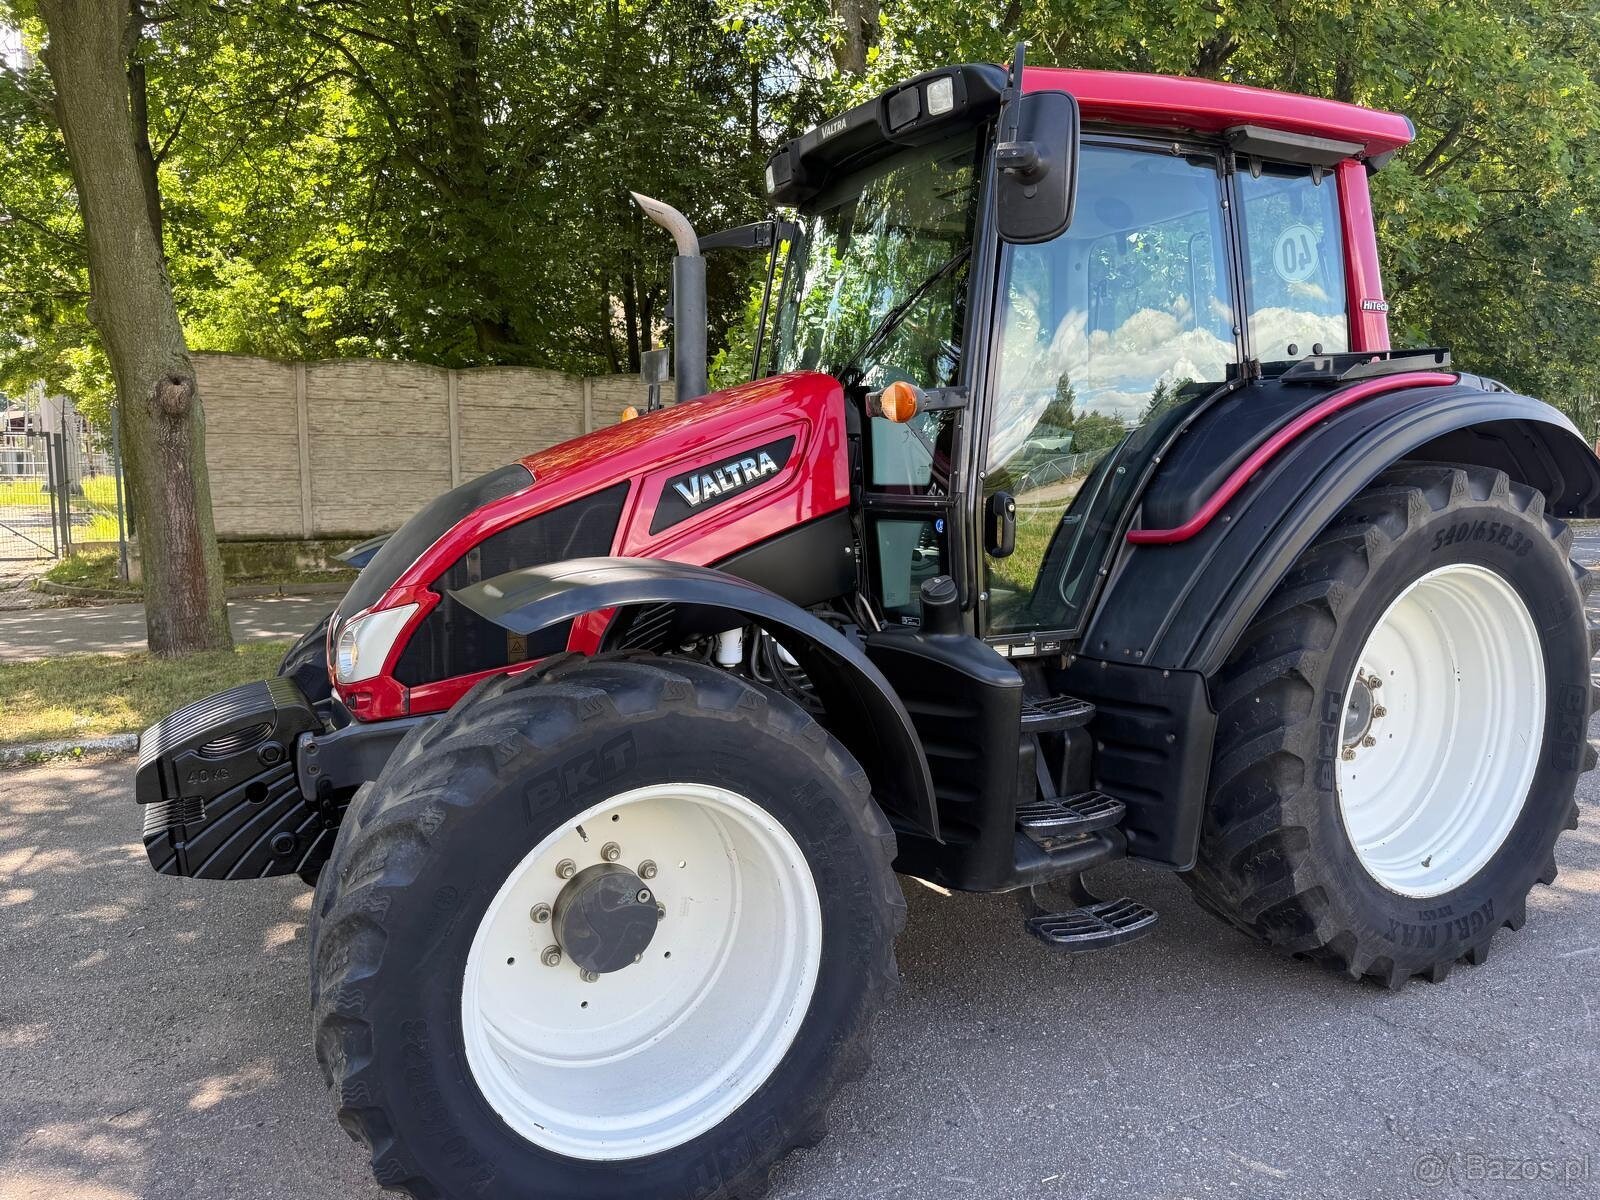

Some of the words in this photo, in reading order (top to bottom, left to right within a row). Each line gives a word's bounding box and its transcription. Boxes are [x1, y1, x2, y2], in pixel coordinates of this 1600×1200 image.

[821, 117, 847, 139] VALTRA
[672, 451, 779, 508] VALTRA
[1430, 519, 1534, 557] 540/65R38
[524, 730, 637, 820] BKT
